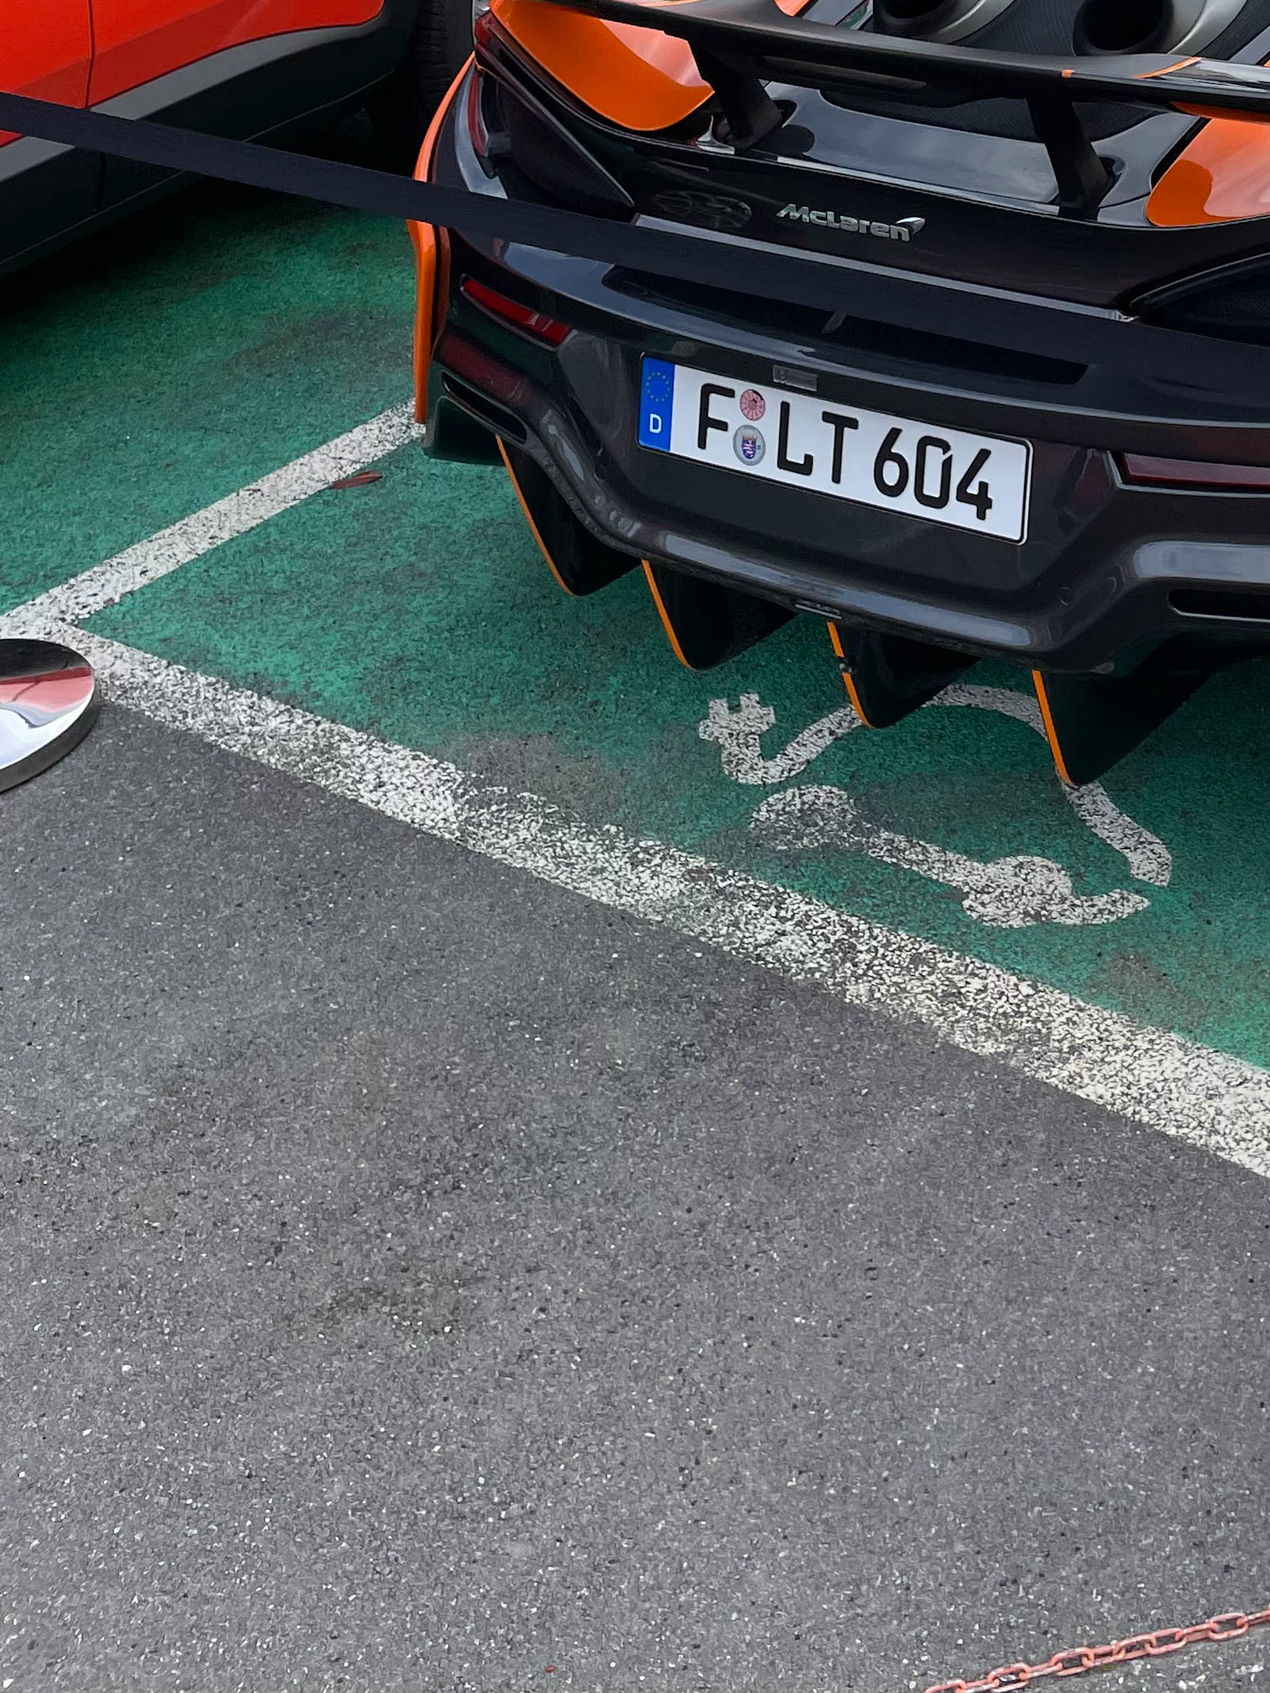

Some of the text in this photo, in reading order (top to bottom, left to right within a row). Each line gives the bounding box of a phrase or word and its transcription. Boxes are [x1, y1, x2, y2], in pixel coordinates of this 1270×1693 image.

[776, 203, 911, 242] McLaren
[649, 413, 662, 434] D
[697, 383, 735, 450] F
[872, 426, 993, 521] 604
